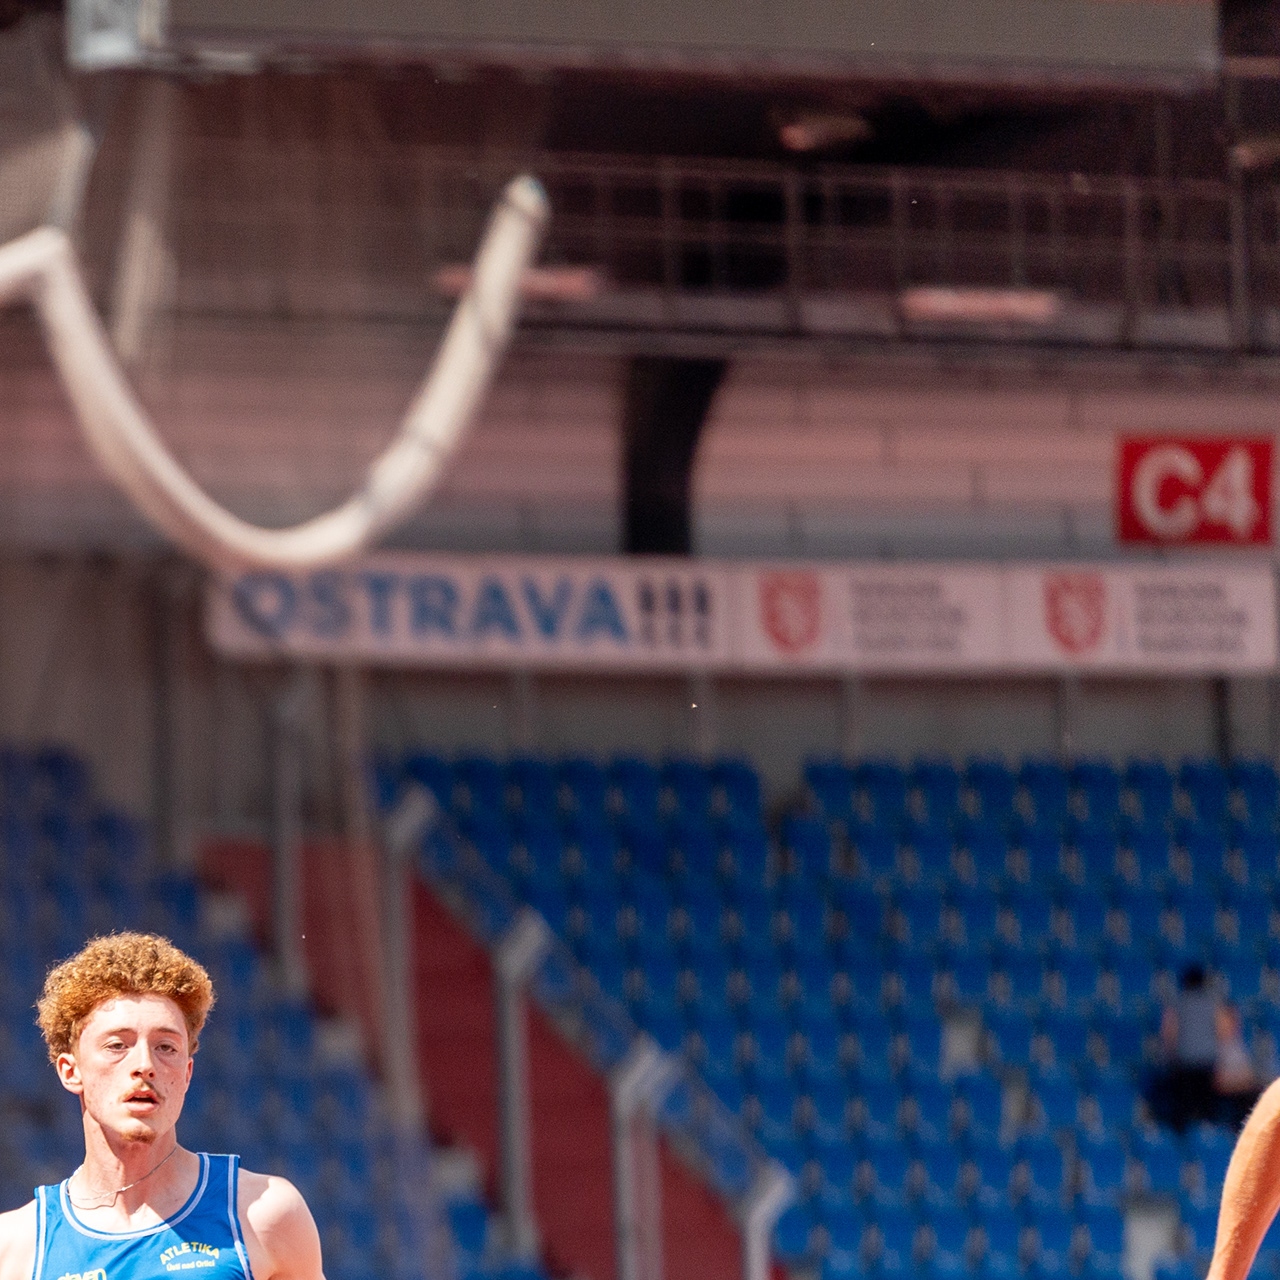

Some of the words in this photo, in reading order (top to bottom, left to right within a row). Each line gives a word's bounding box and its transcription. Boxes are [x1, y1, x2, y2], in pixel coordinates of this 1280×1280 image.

[1130, 446, 1260, 538] C4
[233, 570, 714, 652] OSTRAVA!!!
[160, 1242, 219, 1264] ATLETIKA
